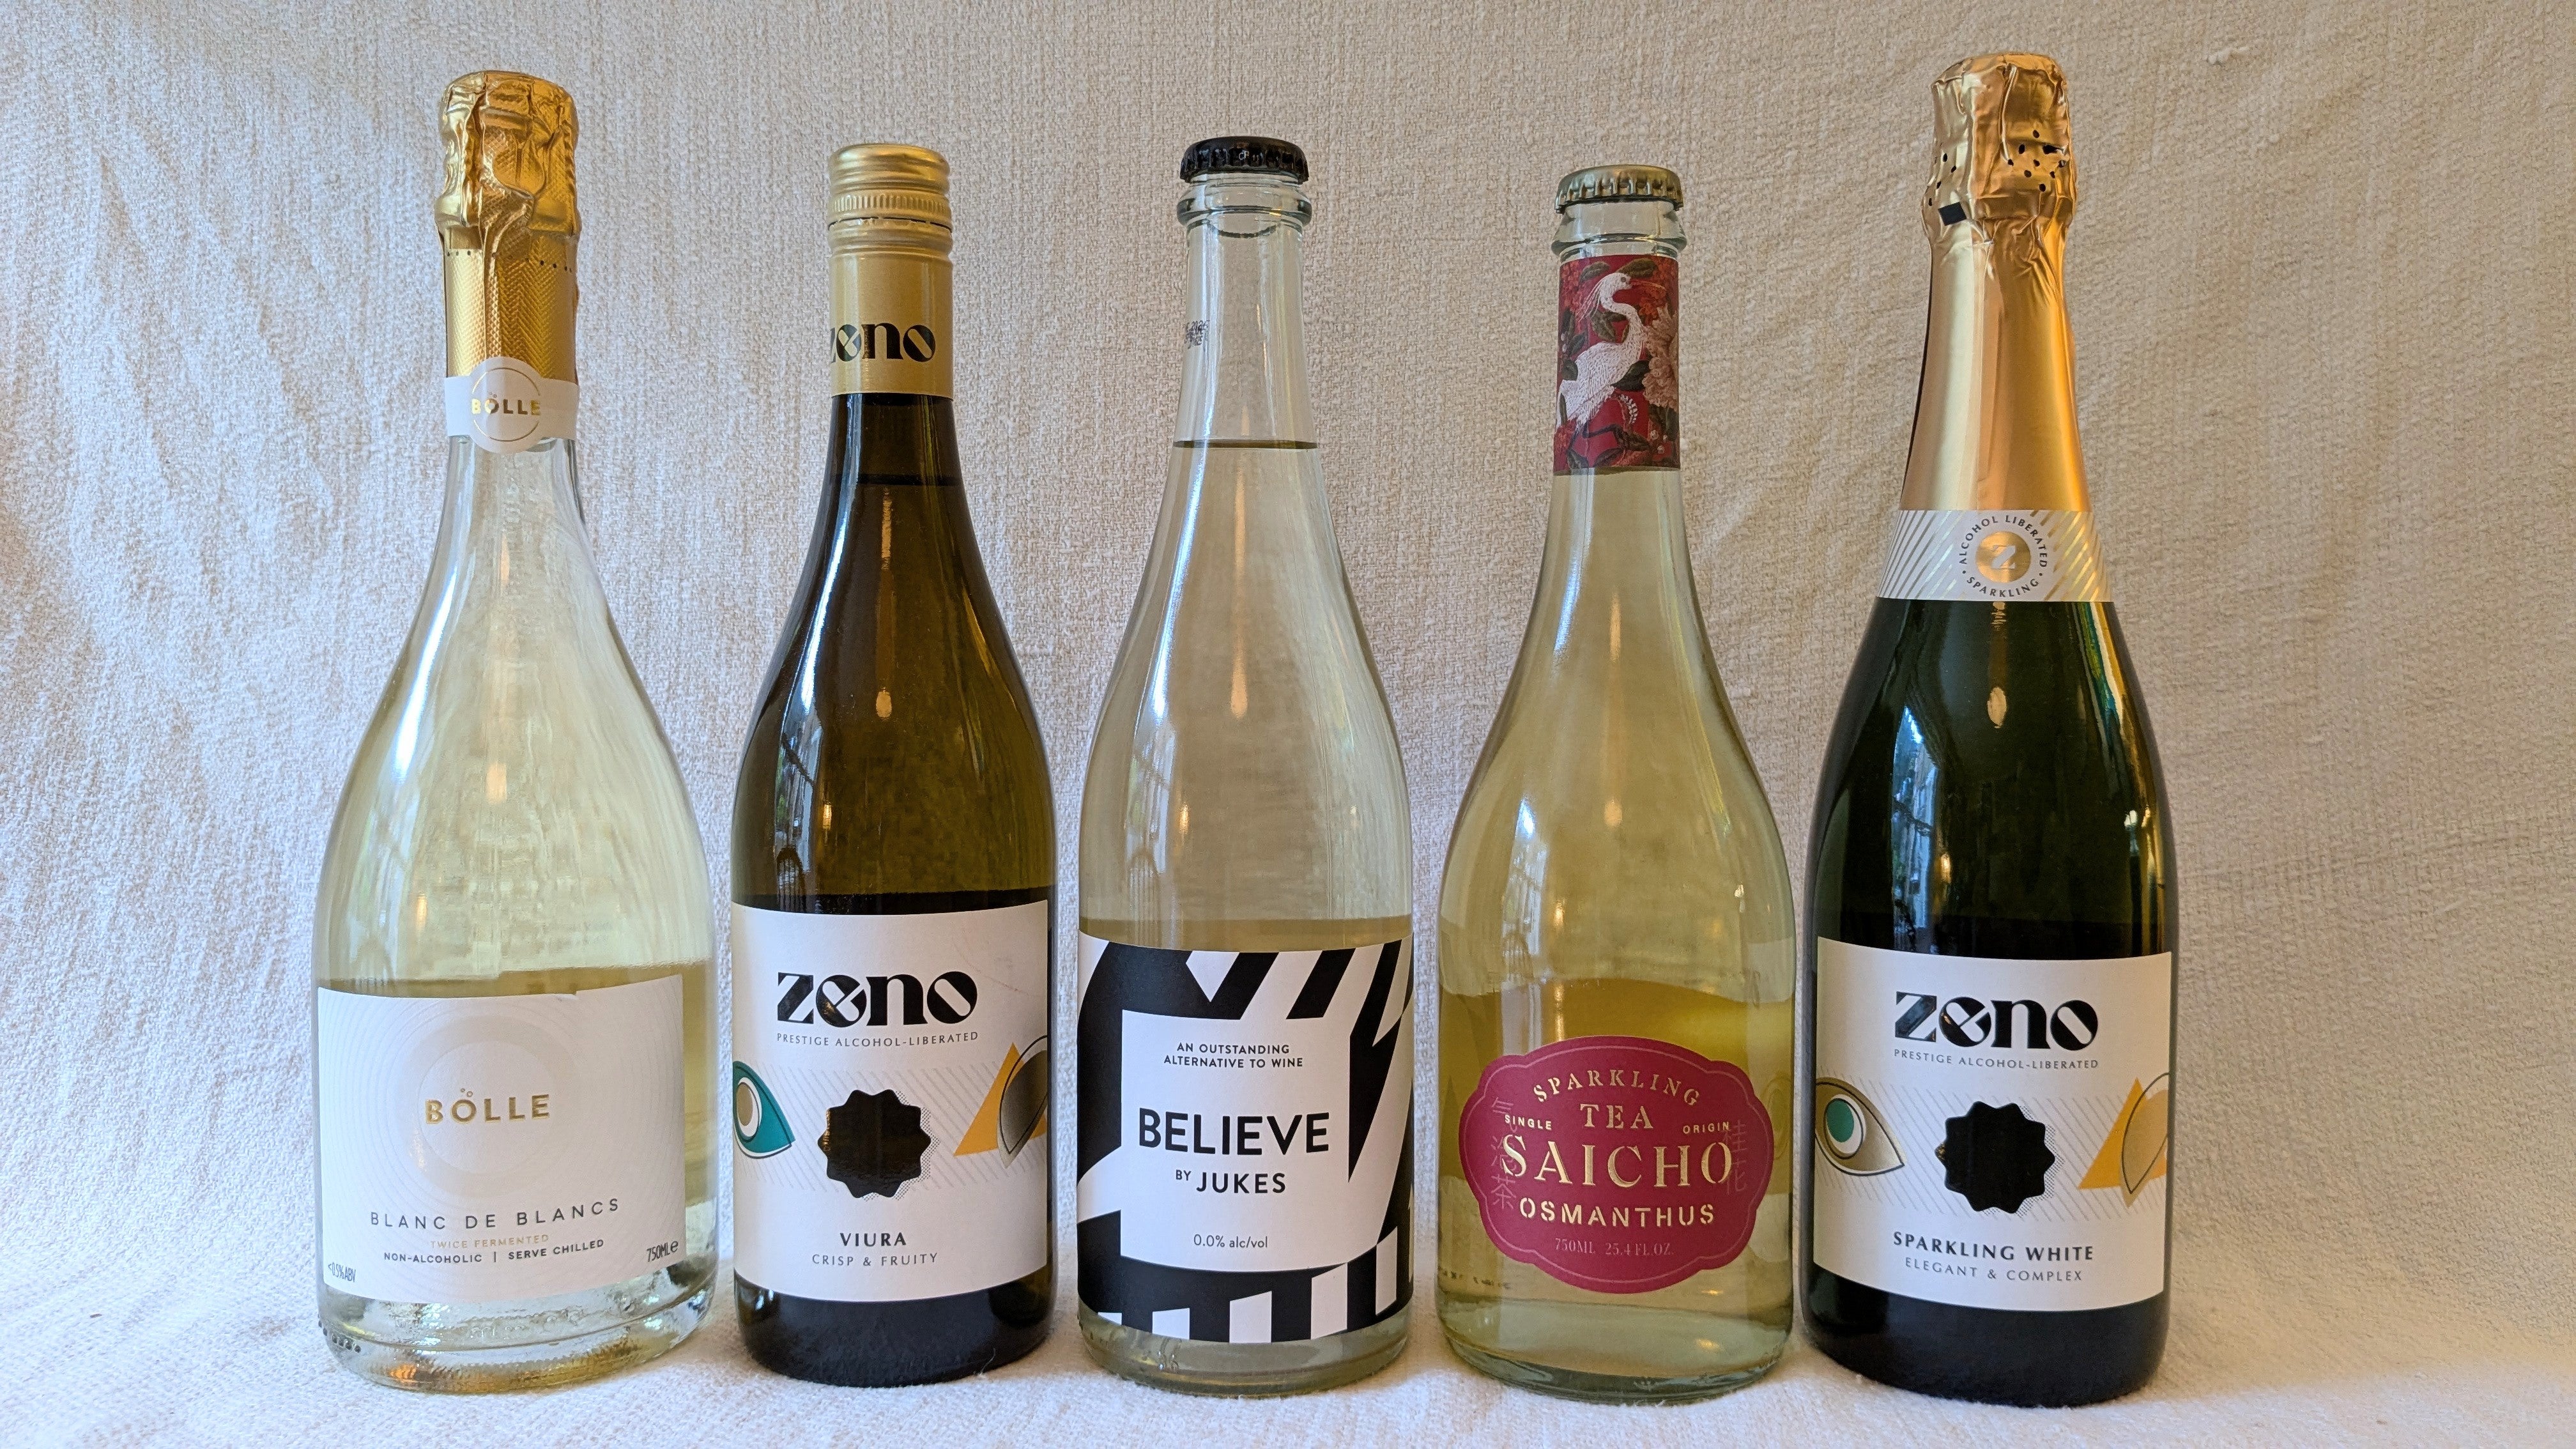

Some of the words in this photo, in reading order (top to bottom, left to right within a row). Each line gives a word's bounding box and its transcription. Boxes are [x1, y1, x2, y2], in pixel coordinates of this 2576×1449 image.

[831, 323, 936, 364] eno
[471, 392, 540, 416] BÖLLE
[1959, 516, 1998, 565] ALCOHOL
[2005, 515, 2048, 567] LIBERATED
[1966, 576, 2039, 597] SPARKLING
[778, 970, 978, 1028] zeno
[1895, 992, 2099, 1051] zeno
[777, 1032, 830, 1046] PRESTIGE
[835, 1031, 979, 1047] ALCOHOL-LIBERATED
[1177, 1043, 1193, 1053] AN
[1199, 1043, 1290, 1055] OUTSTANDING
[1163, 1055, 1244, 1069] ALTERNATIVE
[1250, 1058, 1266, 1068] TO
[1271, 1057, 1303, 1068] WINE
[1894, 1049, 1952, 1064] PRESTIGE
[1958, 1056, 2099, 1070] ALCOHOL-LIBERATED
[1533, 1069, 1700, 1107] SPARKLING
[425, 1088, 550, 1124] BÖLLE
[1580, 1103, 1653, 1130] TEA
[1139, 1107, 1330, 1155] BELIEVE
[1505, 1114, 1552, 1131] SINGLE
[1683, 1121, 1731, 1135] ORIGIN
[1501, 1133, 1733, 1188] SAICHO
[1176, 1169, 1192, 1181] BY
[1196, 1171, 1286, 1194] JUKES
[371, 1211, 446, 1230] BLANC
[465, 1214, 496, 1229] DE
[516, 1198, 620, 1226] BLANCS
[1520, 1197, 1714, 1227] OSMANTHUS
[383, 1252, 482, 1263] NON-ALCOHOLIC
[508, 1247, 547, 1261] SERVE
[553, 1239, 604, 1255] CHILLED
[431, 1238, 468, 1250] TWICE
[475, 1234, 549, 1248] FERMENTED
[840, 1232, 907, 1247] VIURA
[1193, 1234, 1225, 1248] 0.0%
[1229, 1235, 1268, 1249] alc/vol
[1555, 1238, 1596, 1254] 750ML
[1605, 1242, 1632, 1256] 25.4
[1894, 1231, 2015, 1260] SPARKLING
[2025, 1245, 2094, 1261] WHITE
[812, 1254, 854, 1266] CRISP
[862, 1257, 871, 1266] &
[881, 1252, 938, 1266] FRUITY
[1905, 1257, 1977, 1277] ELEGANT
[1987, 1269, 1997, 1279] &
[2007, 1269, 2082, 1282] COMPLEX
